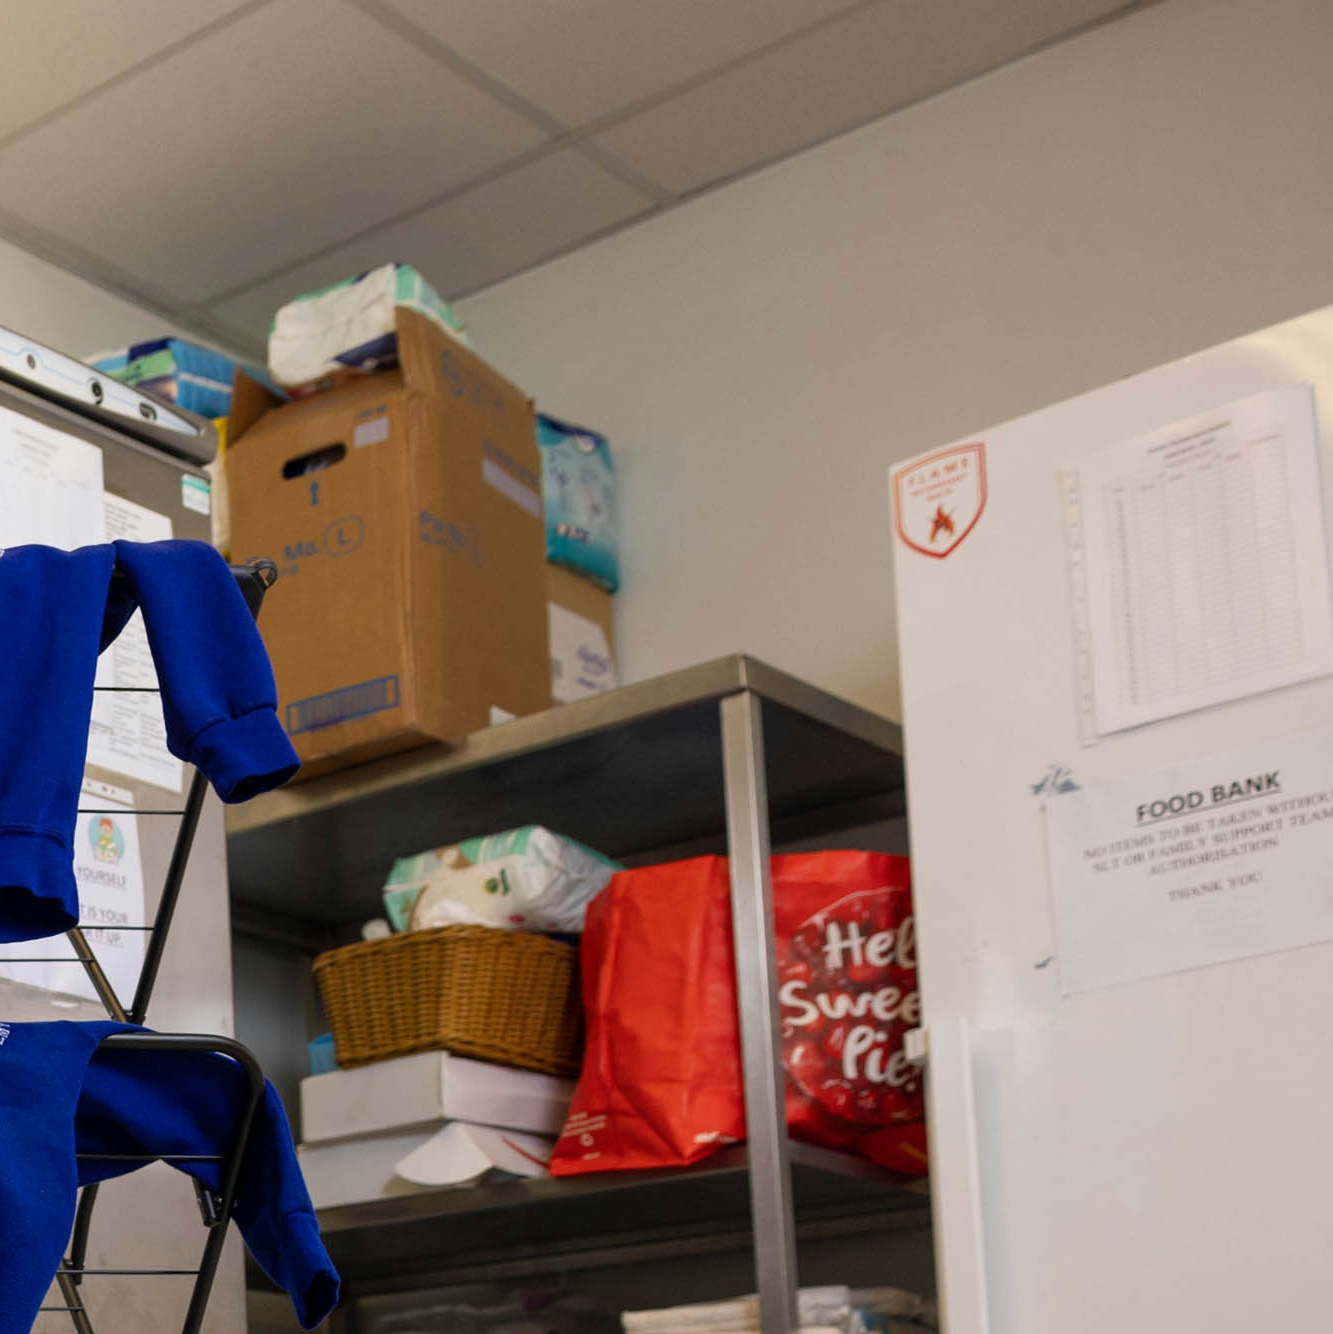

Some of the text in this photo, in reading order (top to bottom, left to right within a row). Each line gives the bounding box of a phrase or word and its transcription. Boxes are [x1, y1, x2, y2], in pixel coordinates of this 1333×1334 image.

[1136, 771, 1282, 824] FOOD BANK
[1266, 789, 1333, 816] WITHOU
